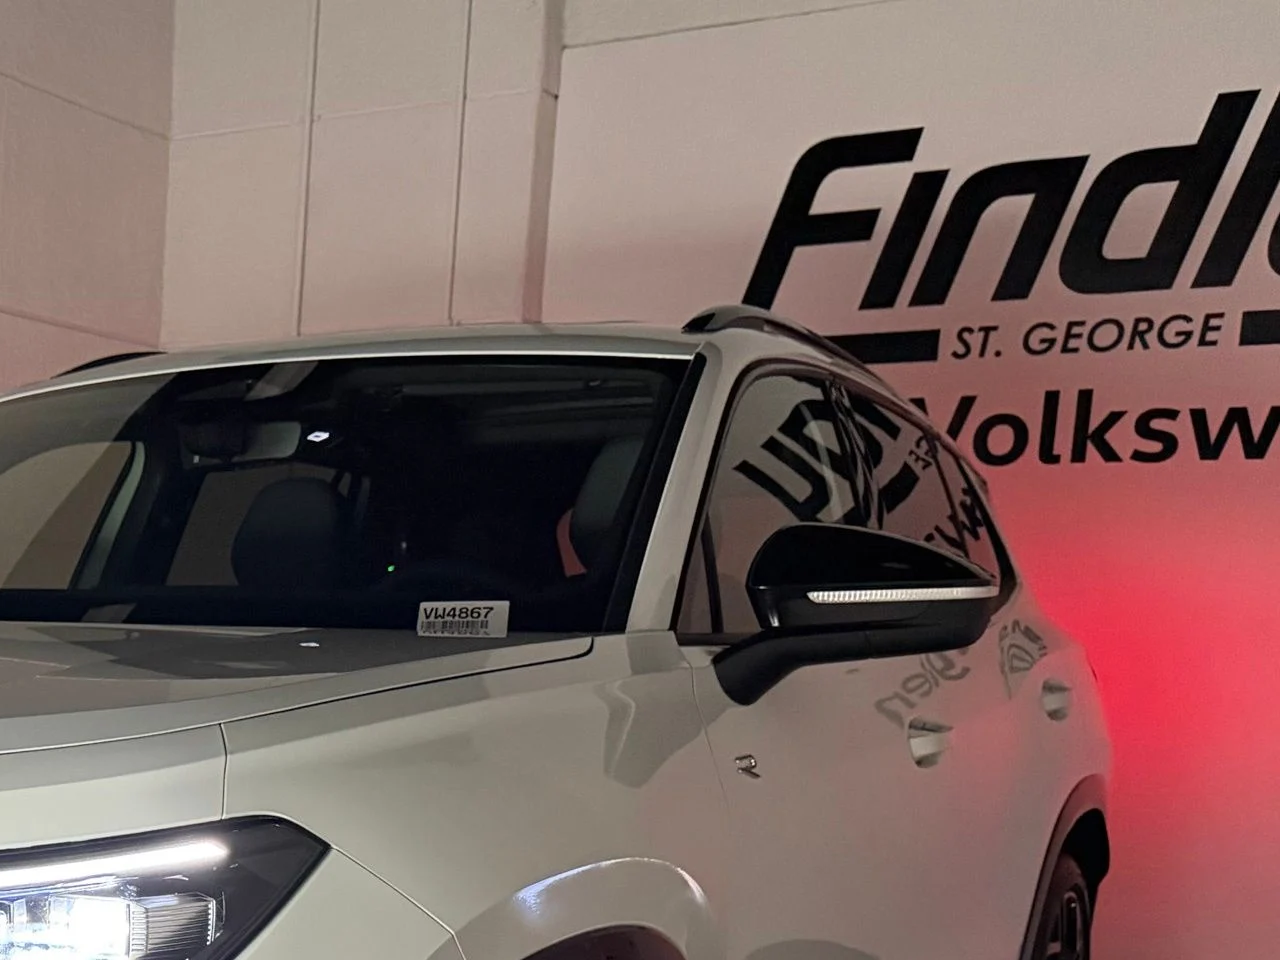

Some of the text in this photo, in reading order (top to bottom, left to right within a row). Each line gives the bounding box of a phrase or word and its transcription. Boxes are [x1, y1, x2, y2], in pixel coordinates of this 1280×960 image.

[741, 88, 1280, 311] Findl
[950, 312, 1225, 360] ST. GEORGE
[423, 606, 495, 620] VW4867
